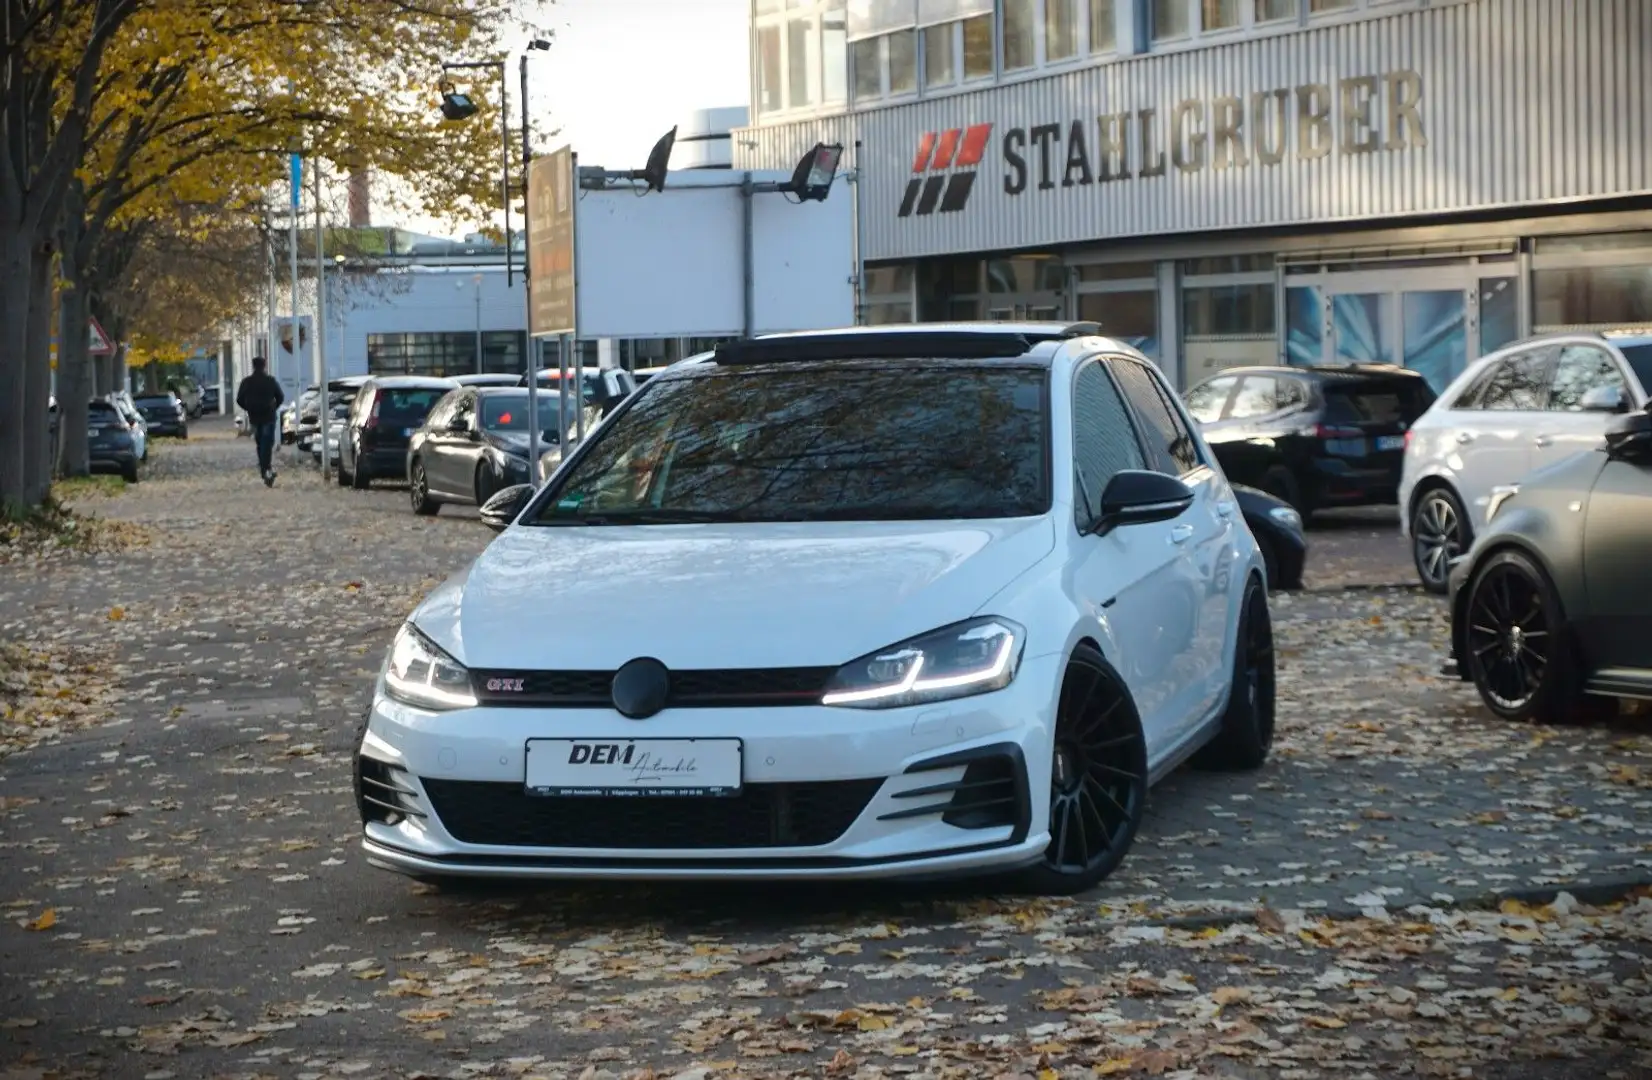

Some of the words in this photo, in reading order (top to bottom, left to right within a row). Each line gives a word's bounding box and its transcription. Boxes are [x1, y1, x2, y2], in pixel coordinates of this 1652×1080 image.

[1003, 69, 1429, 196] STAHLGRUBER
[487, 678, 524, 691] GTI
[568, 744, 635, 764] DEM
